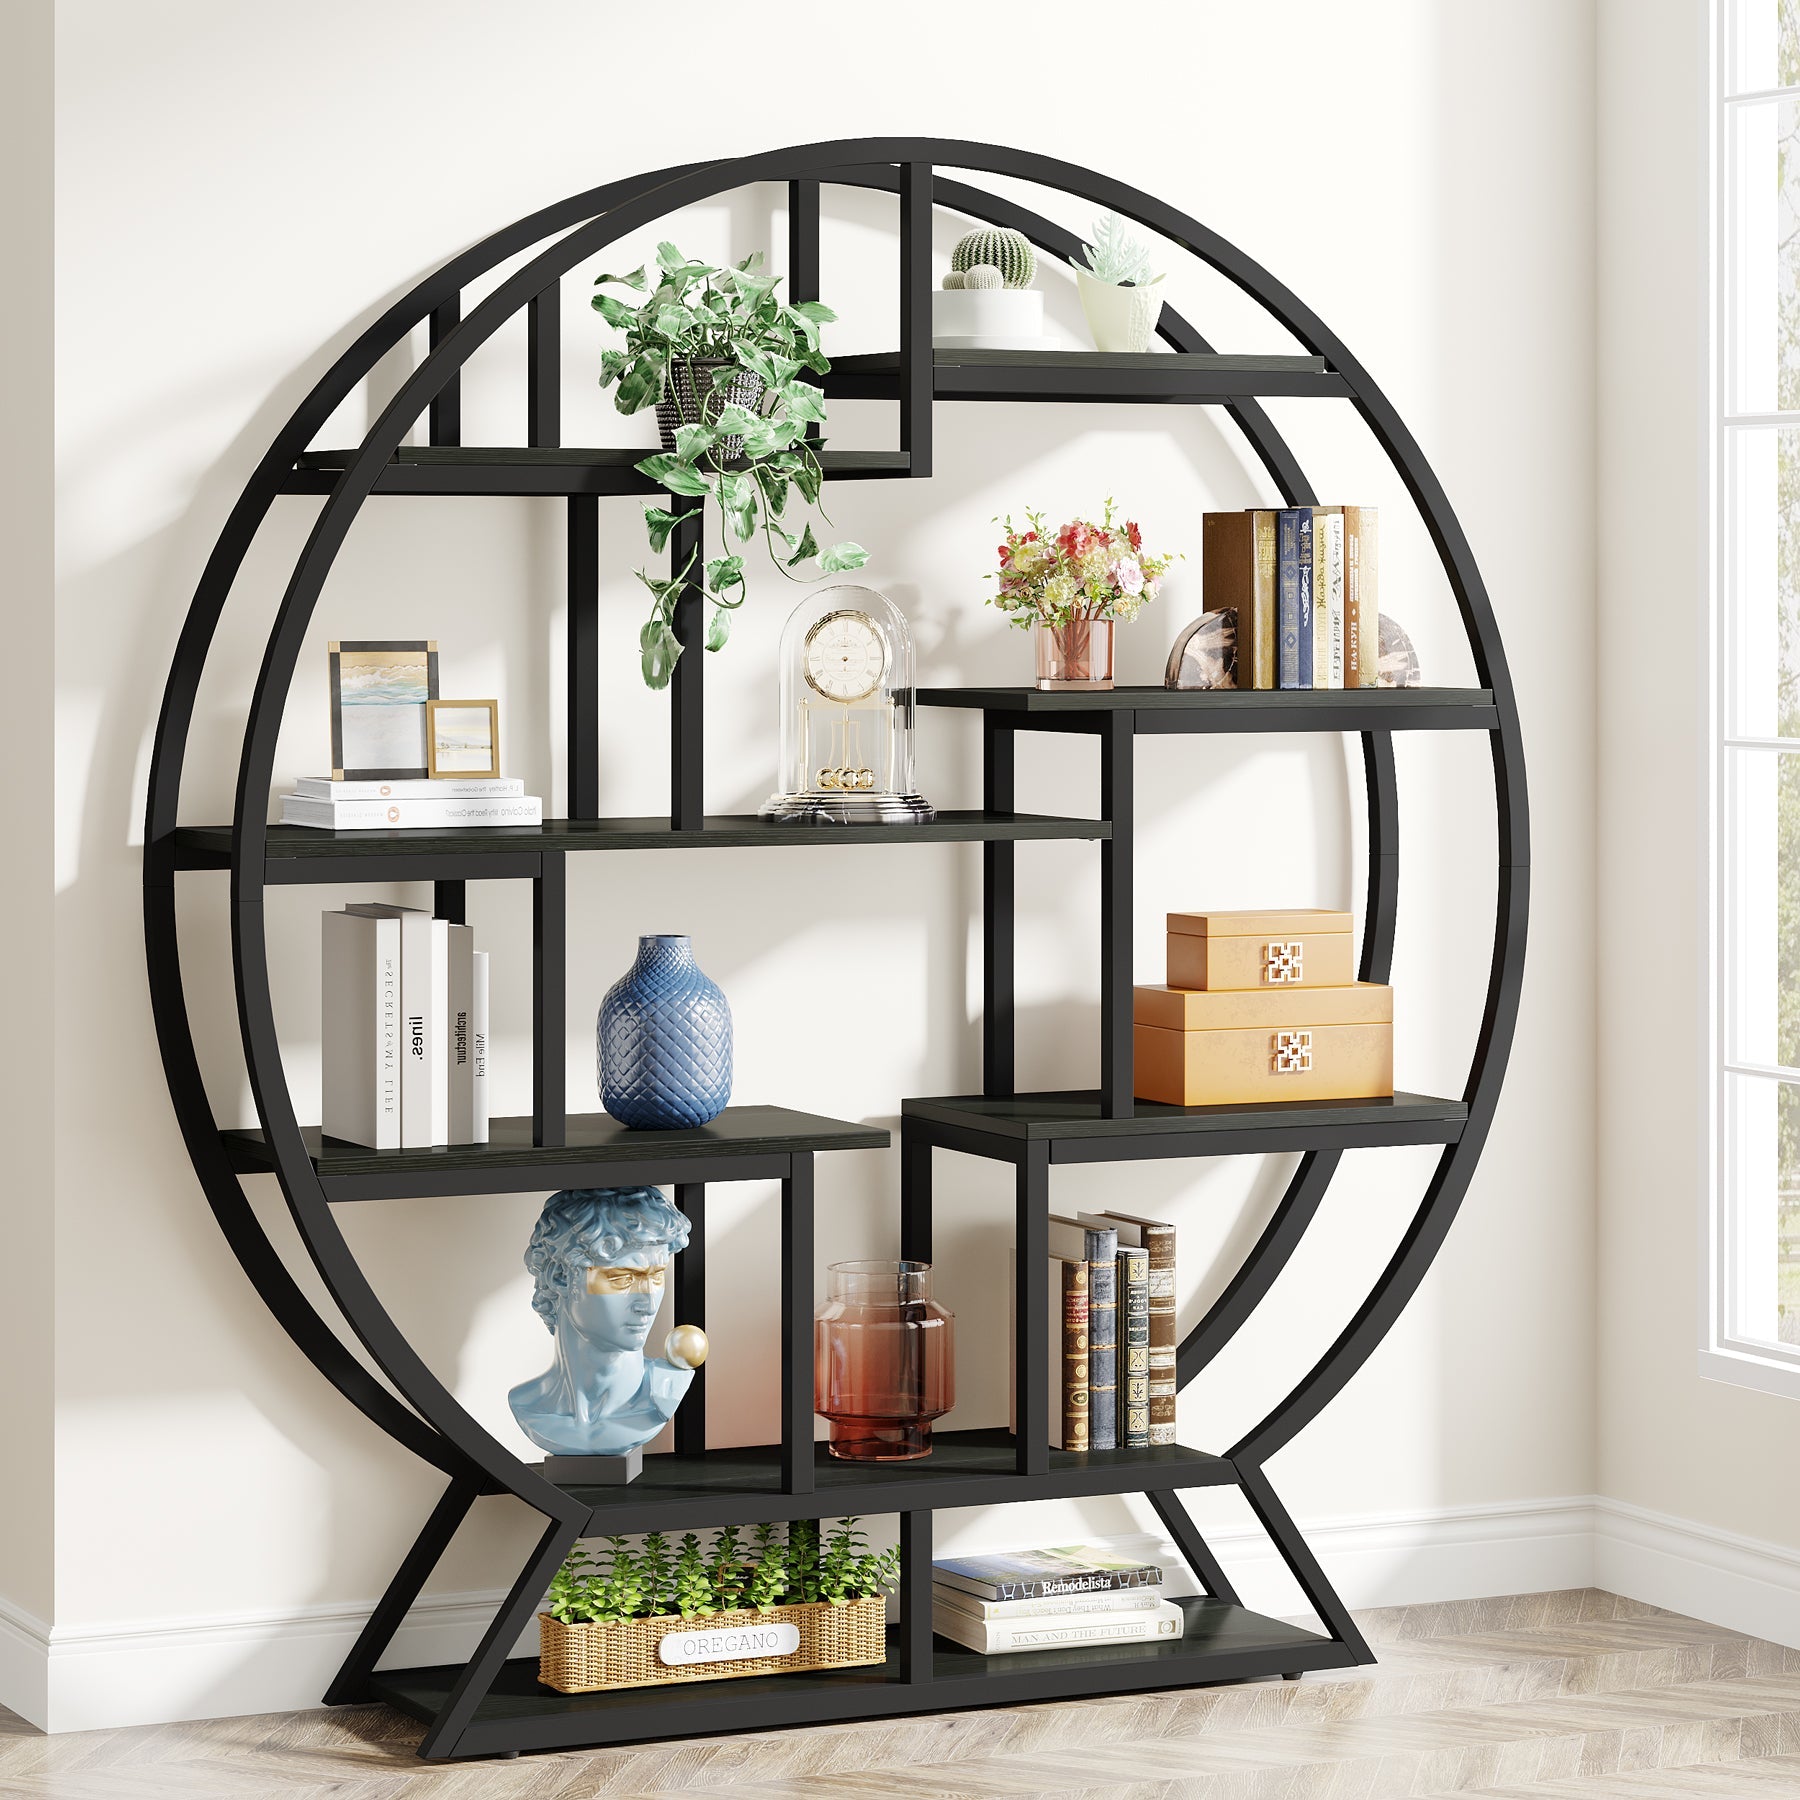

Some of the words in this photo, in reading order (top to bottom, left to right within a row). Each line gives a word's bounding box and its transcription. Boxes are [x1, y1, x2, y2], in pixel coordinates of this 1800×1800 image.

[1317, 524, 1327, 565] жизни
[1316, 567, 1327, 609] Жажда
[1041, 1576, 1112, 1596] Remodelista
[683, 1631, 779, 1656] OREGANO
[1011, 1634, 1040, 1644] MAN
[1044, 1631, 1068, 1641] AND
[1072, 1629, 1097, 1639] THE
[1101, 1625, 1146, 1637] FUTURE
